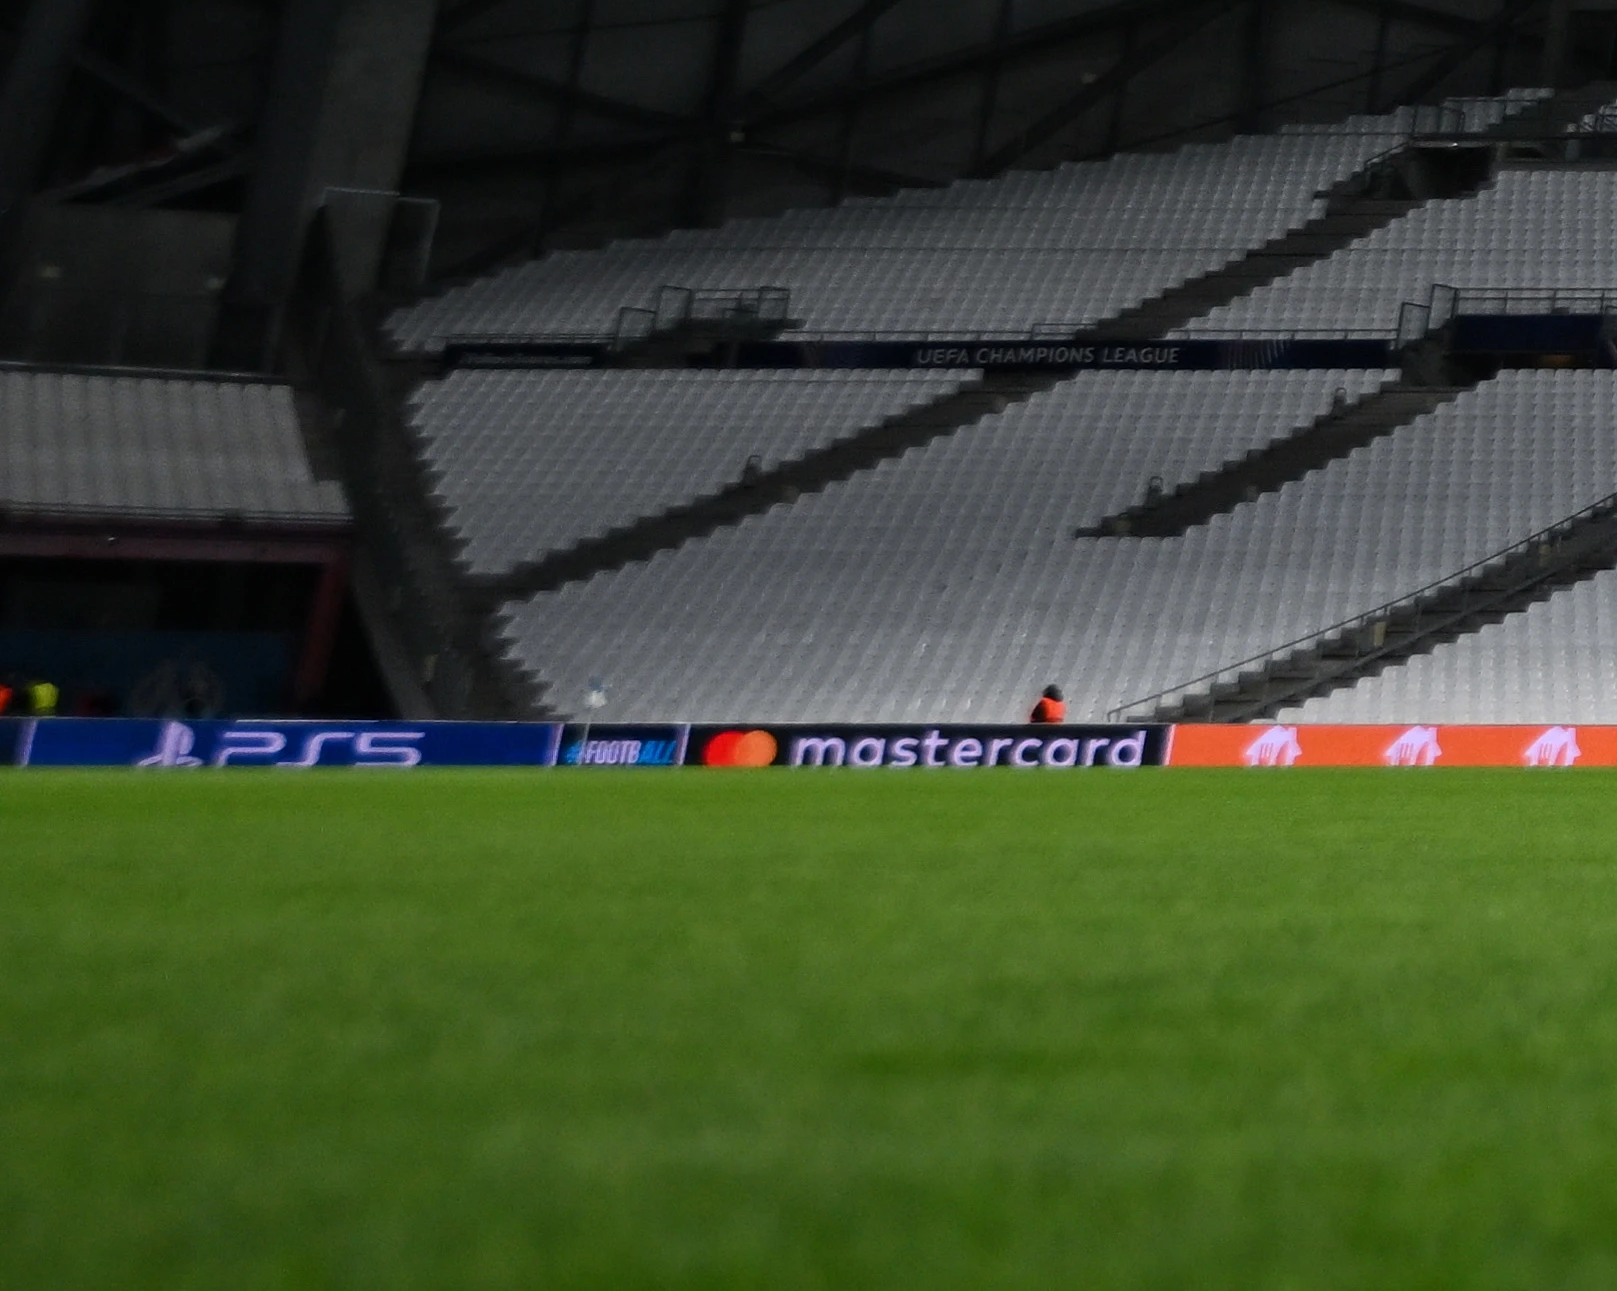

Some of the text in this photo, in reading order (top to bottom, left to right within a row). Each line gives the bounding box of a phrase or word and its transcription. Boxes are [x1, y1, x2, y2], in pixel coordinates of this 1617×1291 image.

[916, 346, 1181, 364] UEFA CHAMPIONS LEAGUE
[216, 732, 427, 766] PS5
[791, 731, 1147, 766] mastercard
